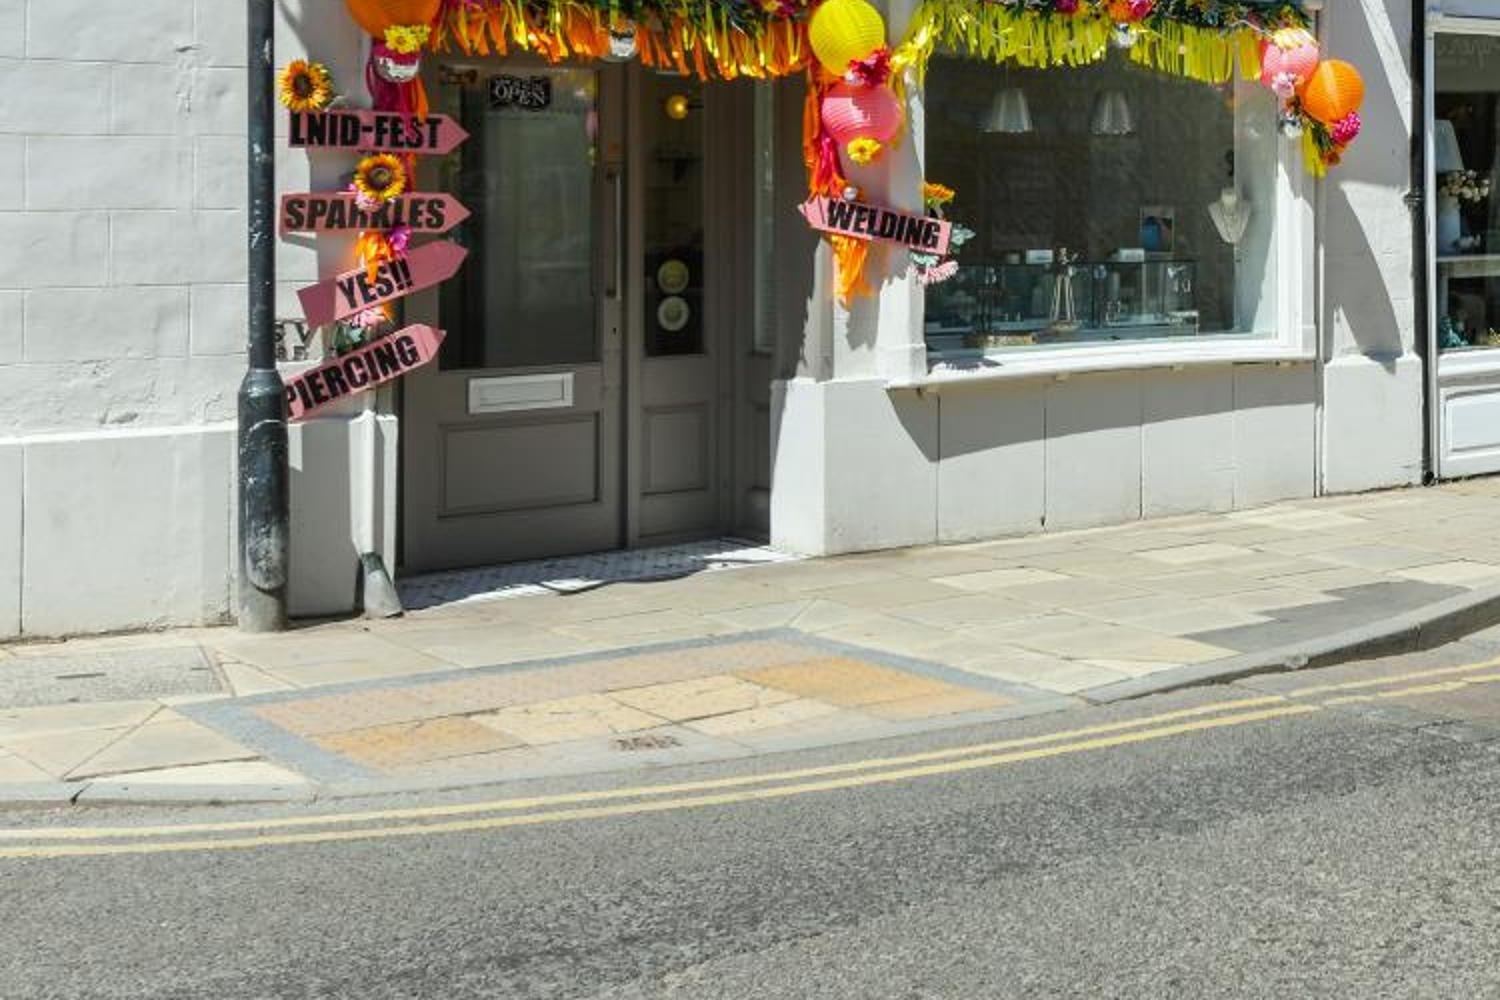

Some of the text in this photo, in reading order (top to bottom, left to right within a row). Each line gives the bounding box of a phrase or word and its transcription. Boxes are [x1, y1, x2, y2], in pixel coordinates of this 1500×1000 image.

[495, 83, 545, 106] OPEN
[290, 113, 442, 148] LNID-FEST
[828, 200, 940, 249] WELDING
[337, 257, 414, 309] YES!!
[288, 336, 420, 417] PIERCING
